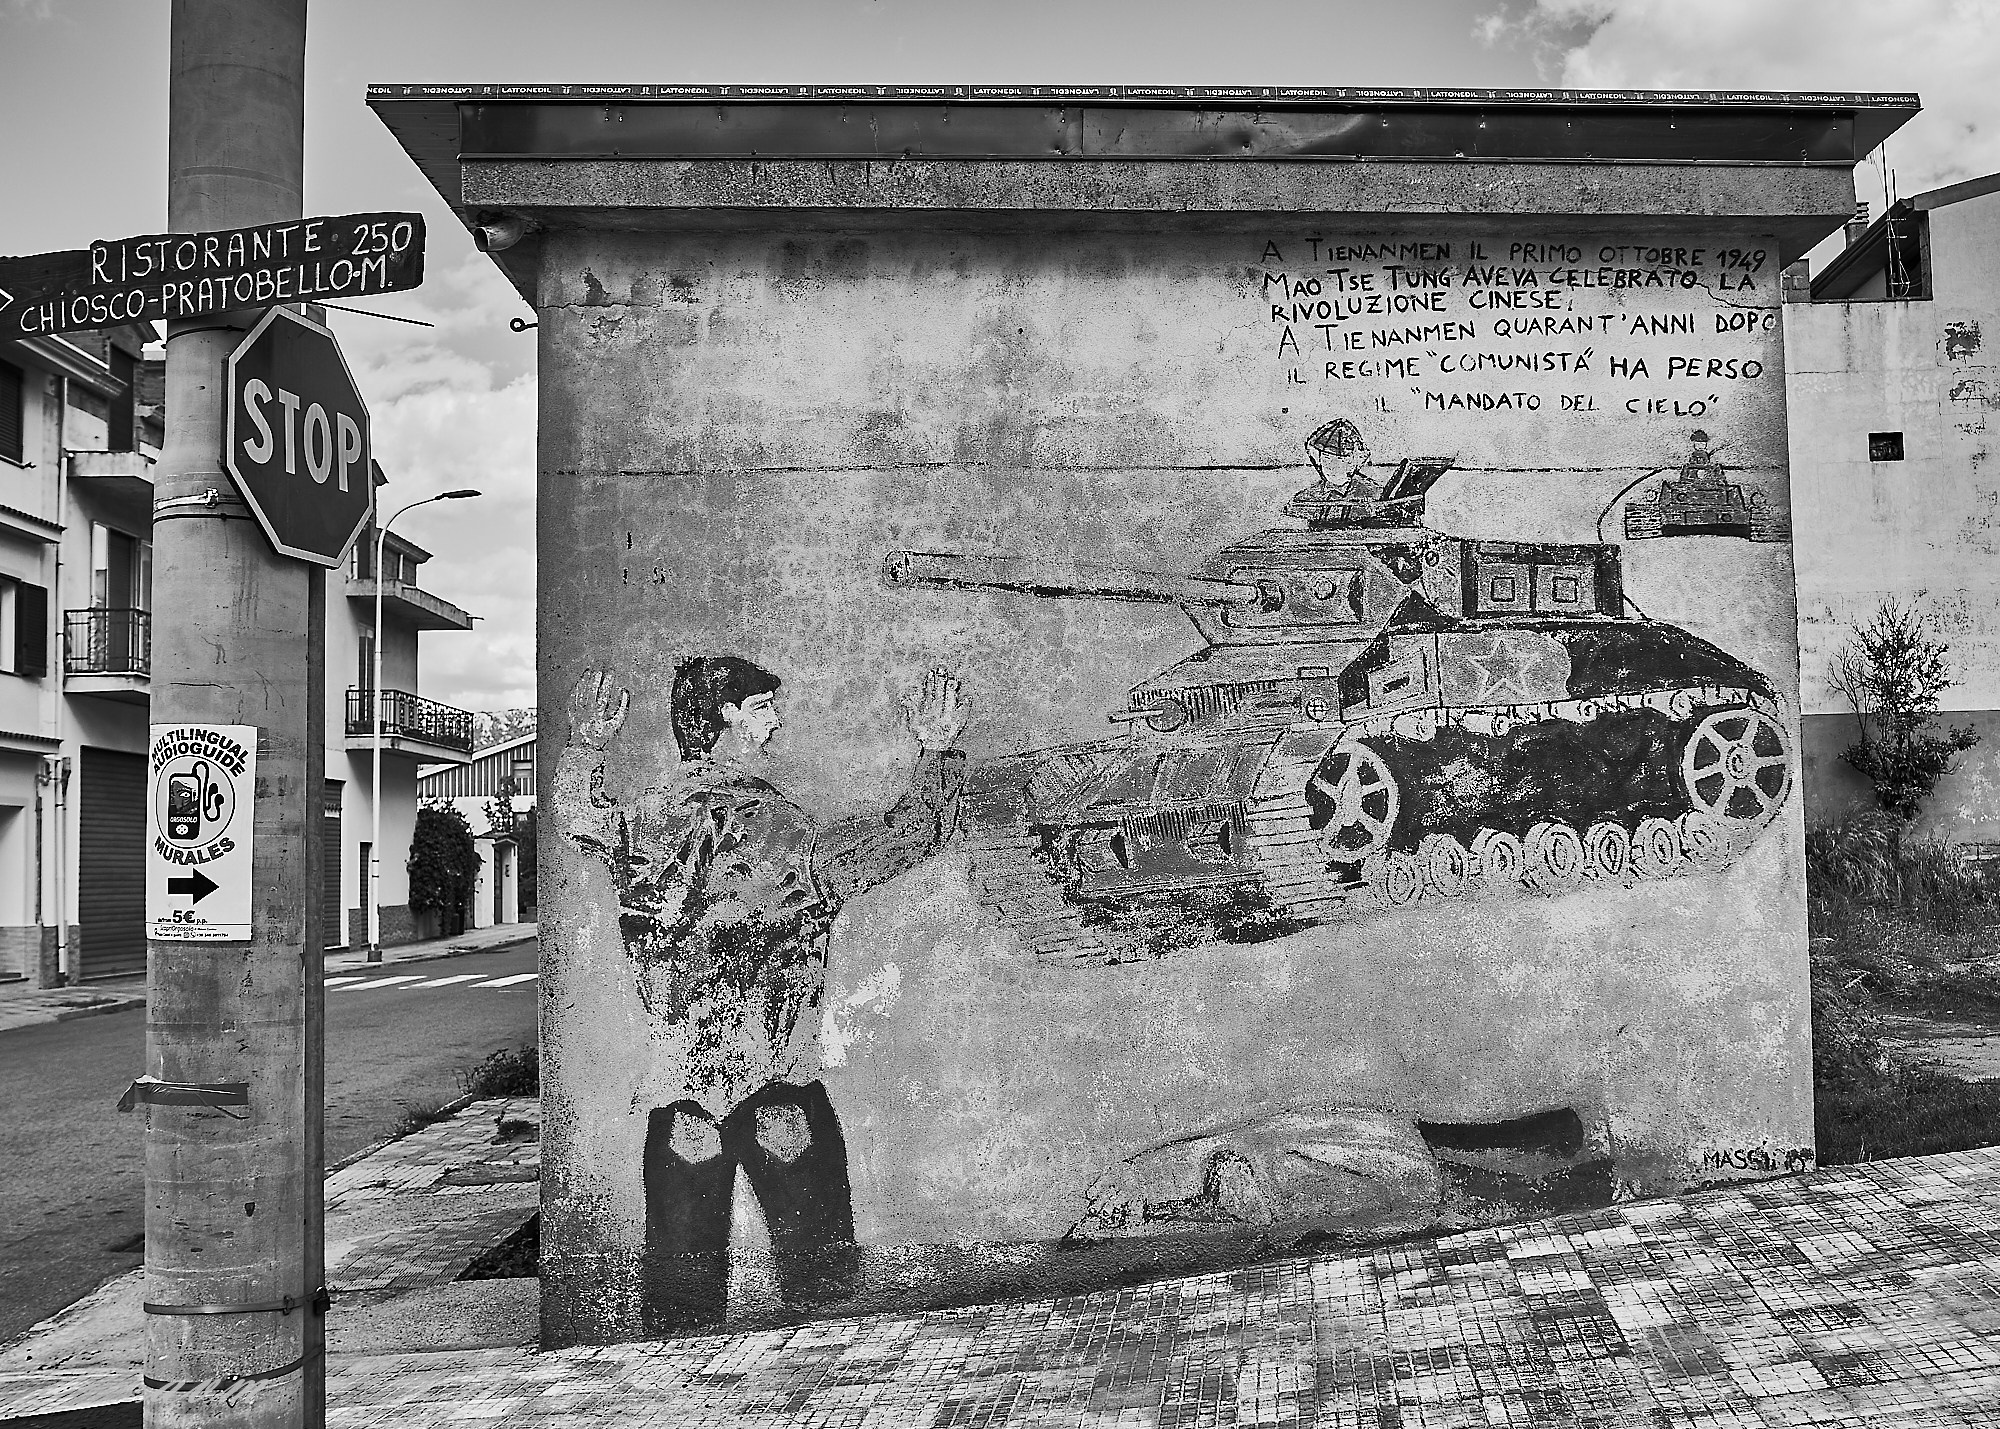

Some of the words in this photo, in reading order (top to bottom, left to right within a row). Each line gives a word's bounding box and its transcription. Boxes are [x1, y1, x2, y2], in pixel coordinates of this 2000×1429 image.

[1280, 88, 1328, 96] LATTONEDIL
[1430, 90, 1479, 98] LATTONEDIL
[1579, 92, 1627, 100] LATTONEDIL
[1726, 93, 1773, 101] LATTONEDIL
[1871, 95, 1917, 103] LATTONEDIL
[92, 220, 324, 285] RISTORANTE
[351, 221, 413, 256] 250
[1261, 240, 1283, 262] A
[1305, 238, 1450, 261] TIENANMEN
[1471, 241, 1488, 260] IL
[1509, 243, 1582, 264] PRIMO
[1599, 246, 1706, 266] OTTOBRE
[1717, 249, 1767, 272] 1949
[1382, 265, 1450, 290] TUNG
[1462, 265, 1538, 287] AVEVA
[1550, 265, 1698, 289] CELEBRATO
[1719, 274, 1756, 291] LA
[1271, 292, 1447, 323] RIVOLUZIONE
[1278, 325, 1300, 359] A
[1314, 320, 1475, 351] TIENANMEN
[1494, 313, 1695, 338] QUARANT'ANNI
[1287, 368, 1306, 384] IL
[1325, 357, 1420, 379] REGIME
[1610, 356, 1649, 381] HA
[1668, 356, 1763, 380] PERSO
[1375, 397, 1392, 412] IL
[1561, 394, 1600, 411] DEL
[242, 378, 362, 493] STOP
[152, 728, 249, 765] MULTILINGUAL
[153, 742, 246, 777] AUDIOGUIDE
[169, 816, 198, 824] ORGOSOLO
[154, 835, 236, 866] MURALES
[172, 909, 196, 924] 5€
